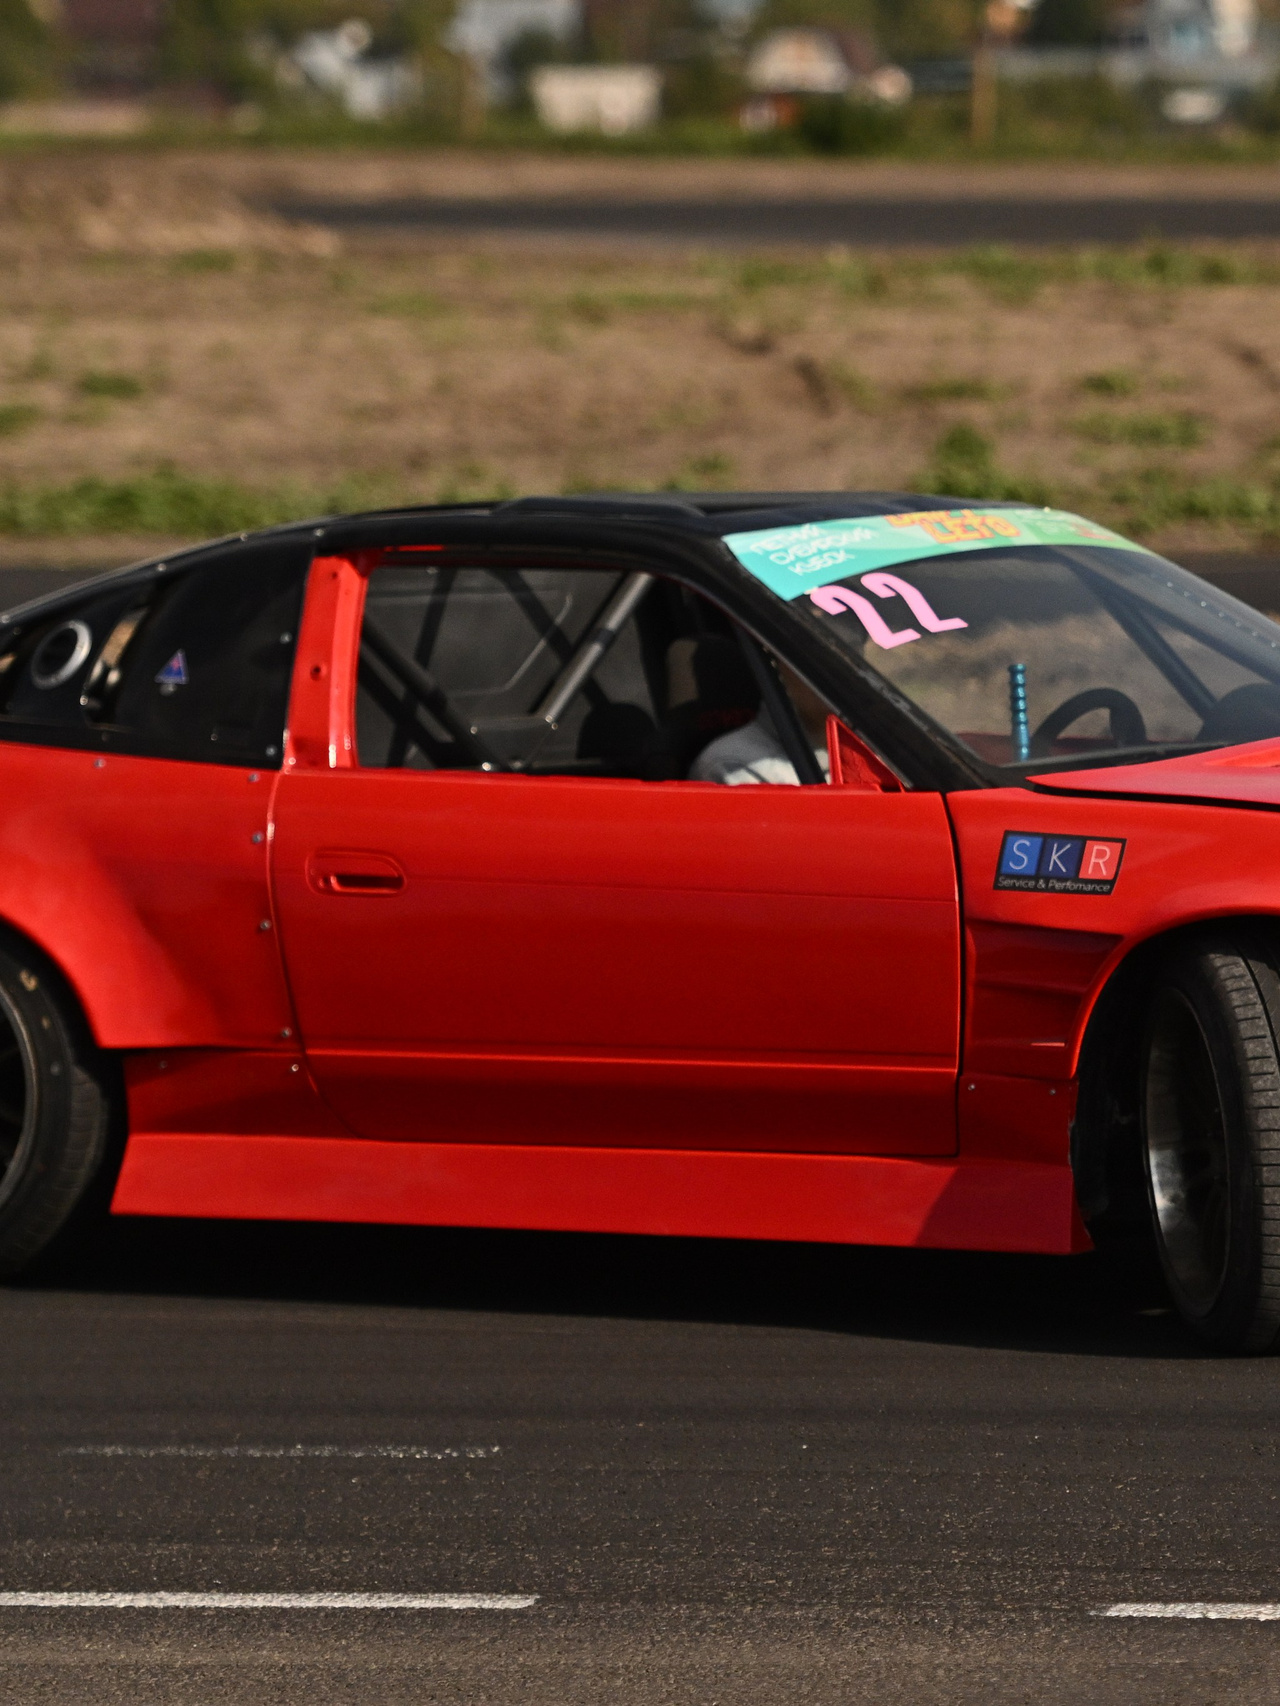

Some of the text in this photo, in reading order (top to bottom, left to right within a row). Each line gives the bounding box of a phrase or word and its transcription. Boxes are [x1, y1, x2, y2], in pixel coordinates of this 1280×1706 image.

[809, 572, 968, 650] 22
[997, 876, 1036, 890] Service
[1037, 878, 1046, 890] &
